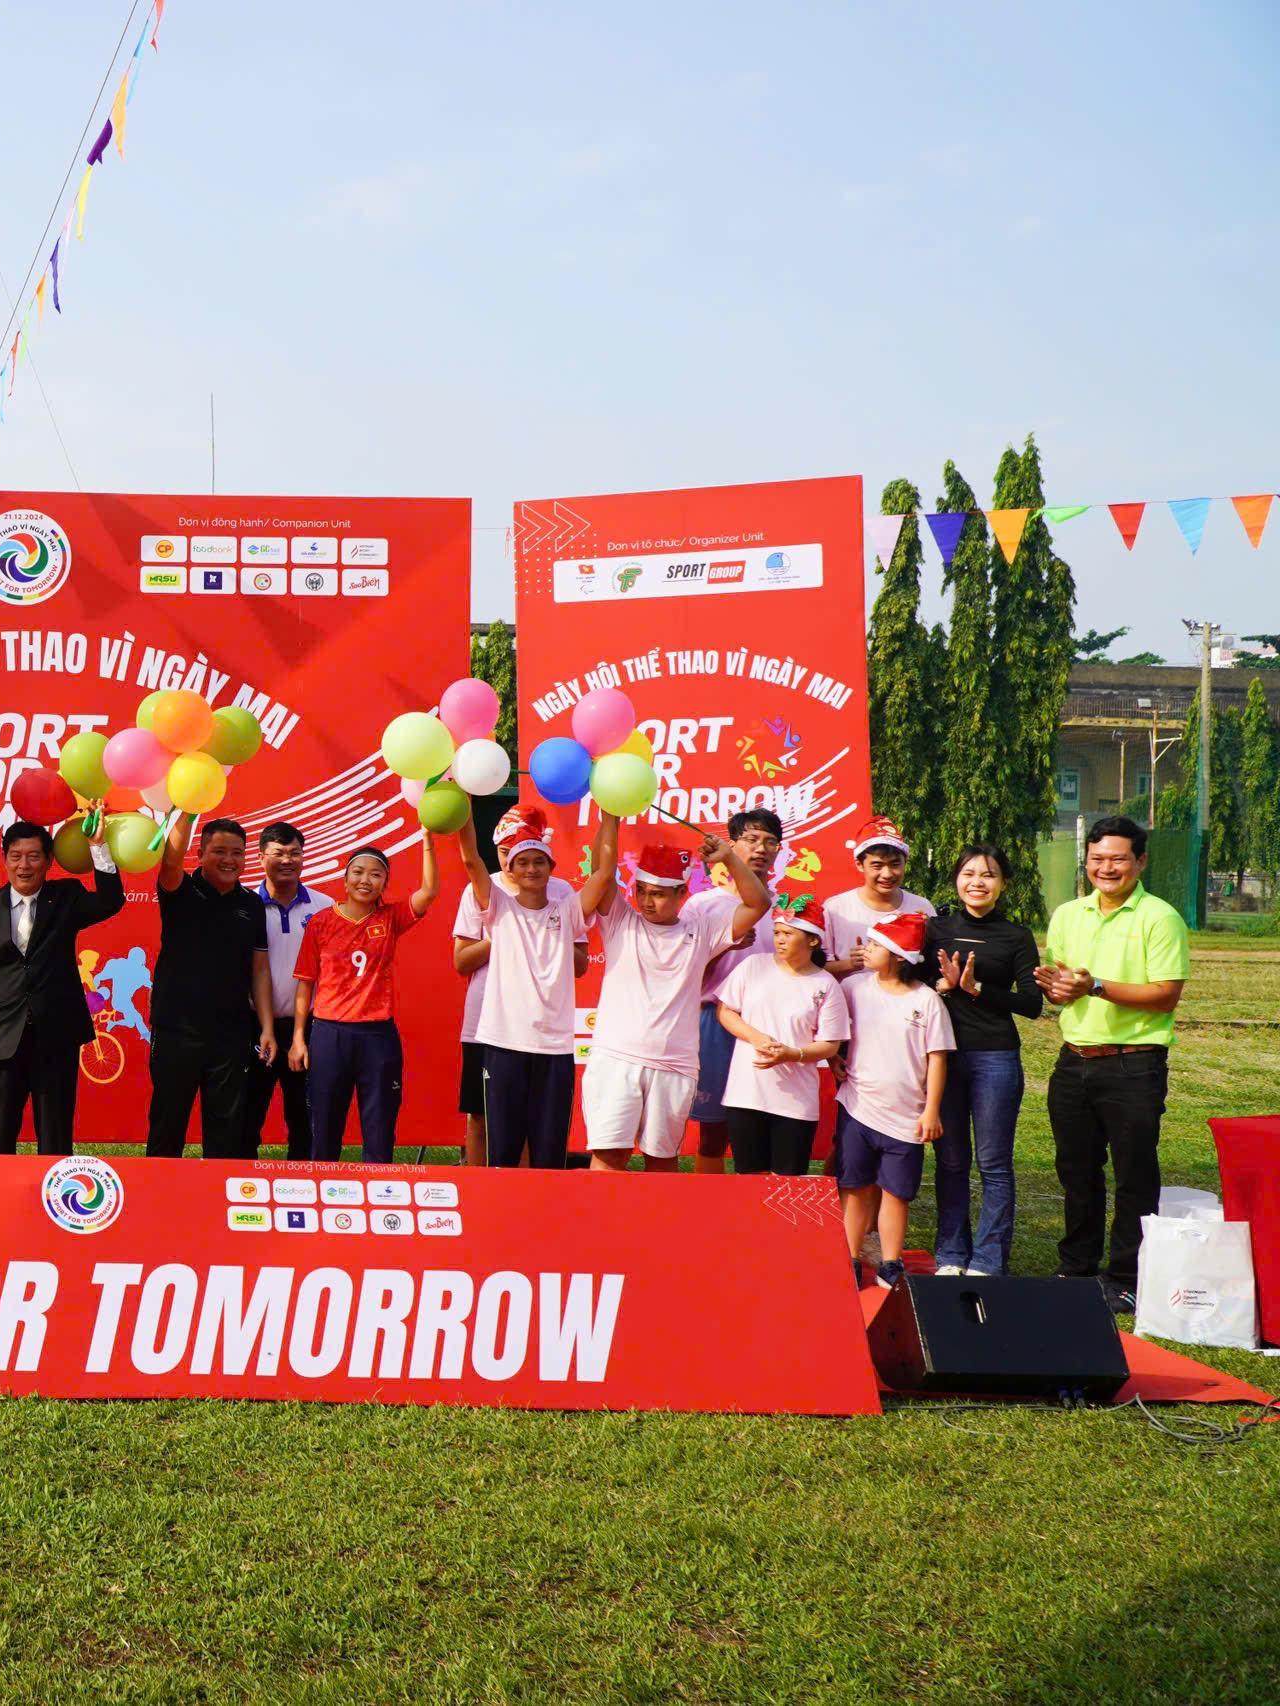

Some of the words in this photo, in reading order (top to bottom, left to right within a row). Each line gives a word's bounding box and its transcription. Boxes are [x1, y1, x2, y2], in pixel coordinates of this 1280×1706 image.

[272, 518, 328, 529] Companion
[331, 519, 351, 528] Unit
[0, 525, 18, 538] THAO
[48, 538, 58, 552] MAI
[689, 533, 740, 547] Organizer
[742, 532, 765, 543] Unit
[5, 584, 20, 593] FOR
[23, 565, 58, 593] TOMORROW
[666, 563, 707, 579] SPORT
[709, 565, 743, 579] GROUP
[1, 631, 88, 674] THAO
[99, 630, 136, 682] VÌ
[136, 652, 230, 706] NGÀY
[231, 682, 301, 750] MAI
[531, 682, 584, 723] NGÀY
[622, 647, 662, 683] THỂ
[665, 650, 719, 675] THAO
[726, 647, 749, 677] VÌ
[749, 655, 808, 690] NGÀY
[805, 672, 854, 711] MAI
[636, 716, 734, 754] ORT
[578, 782, 815, 826] ORROW
[123, 889, 149, 903] ăm
[351, 951, 368, 977] 9
[587, 951, 605, 963] HỐ
[62, 1167, 78, 1178] THAO
[103, 1178, 112, 1190] MAI
[348, 1163, 404, 1174] Companion
[406, 1165, 426, 1174] Unit
[53, 1198, 67, 1217] SPORT
[68, 1215, 81, 1224] FOR
[83, 1200, 113, 1224] TOMORROW
[85, 1262, 625, 1383] TOMORROW
